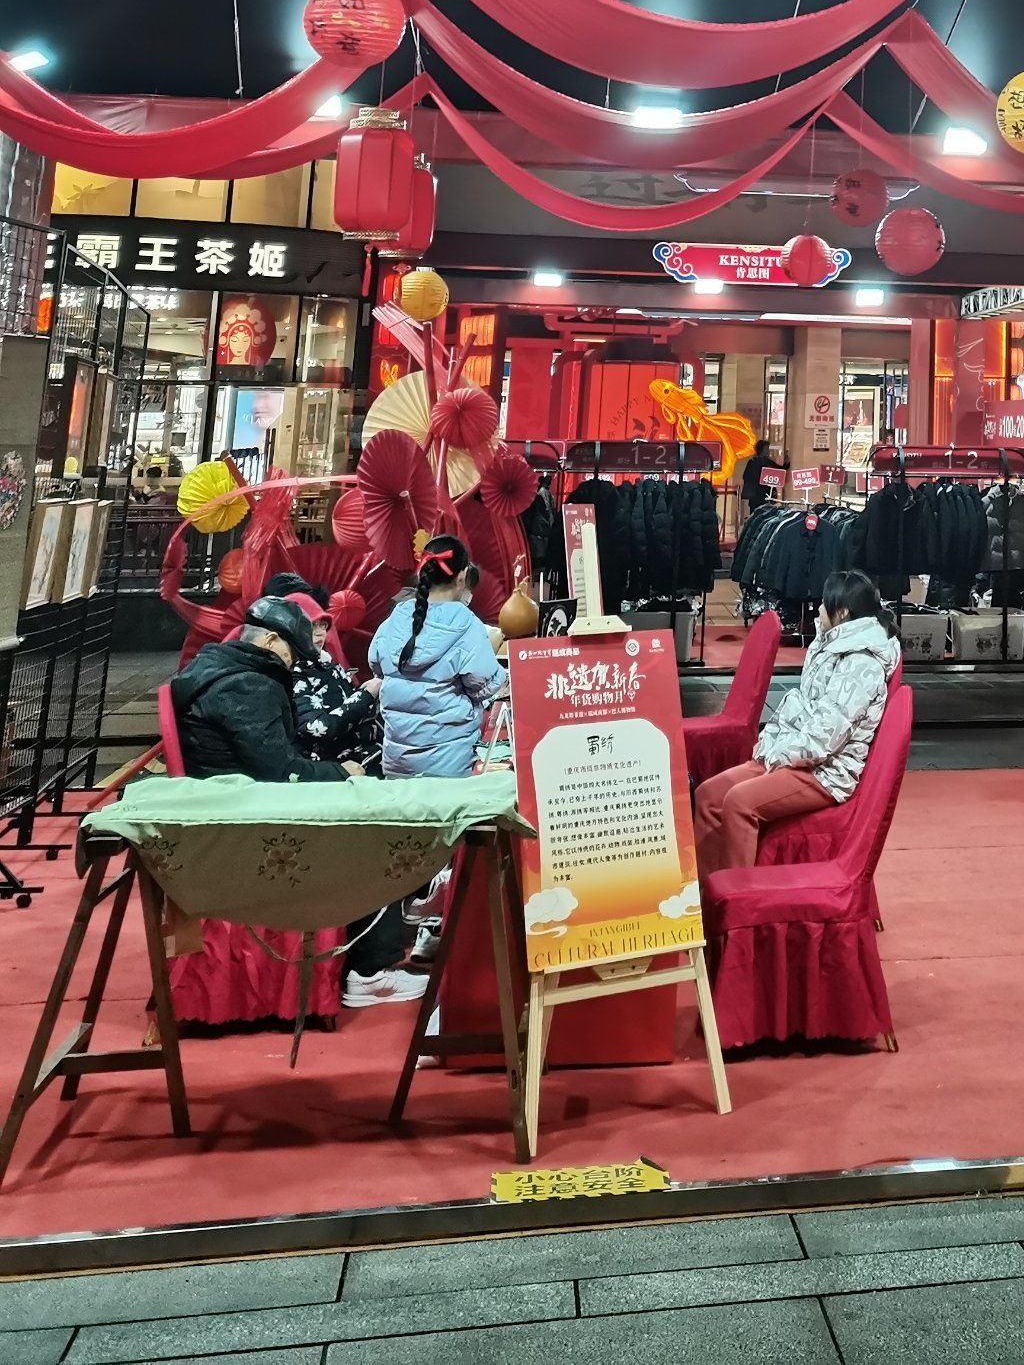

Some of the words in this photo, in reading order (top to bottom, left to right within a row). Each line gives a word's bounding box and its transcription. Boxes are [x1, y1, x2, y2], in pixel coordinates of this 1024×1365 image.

[74, 233, 288, 278] 霸王茶姬
[544, 661, 647, 700] 非遗贺新春
[571, 691, 624, 708] 年货购物月
[586, 734, 615, 756] 蜀绣
[515, 1166, 644, 1185] 小心台阶
[515, 1177, 647, 1197] 注意安全
